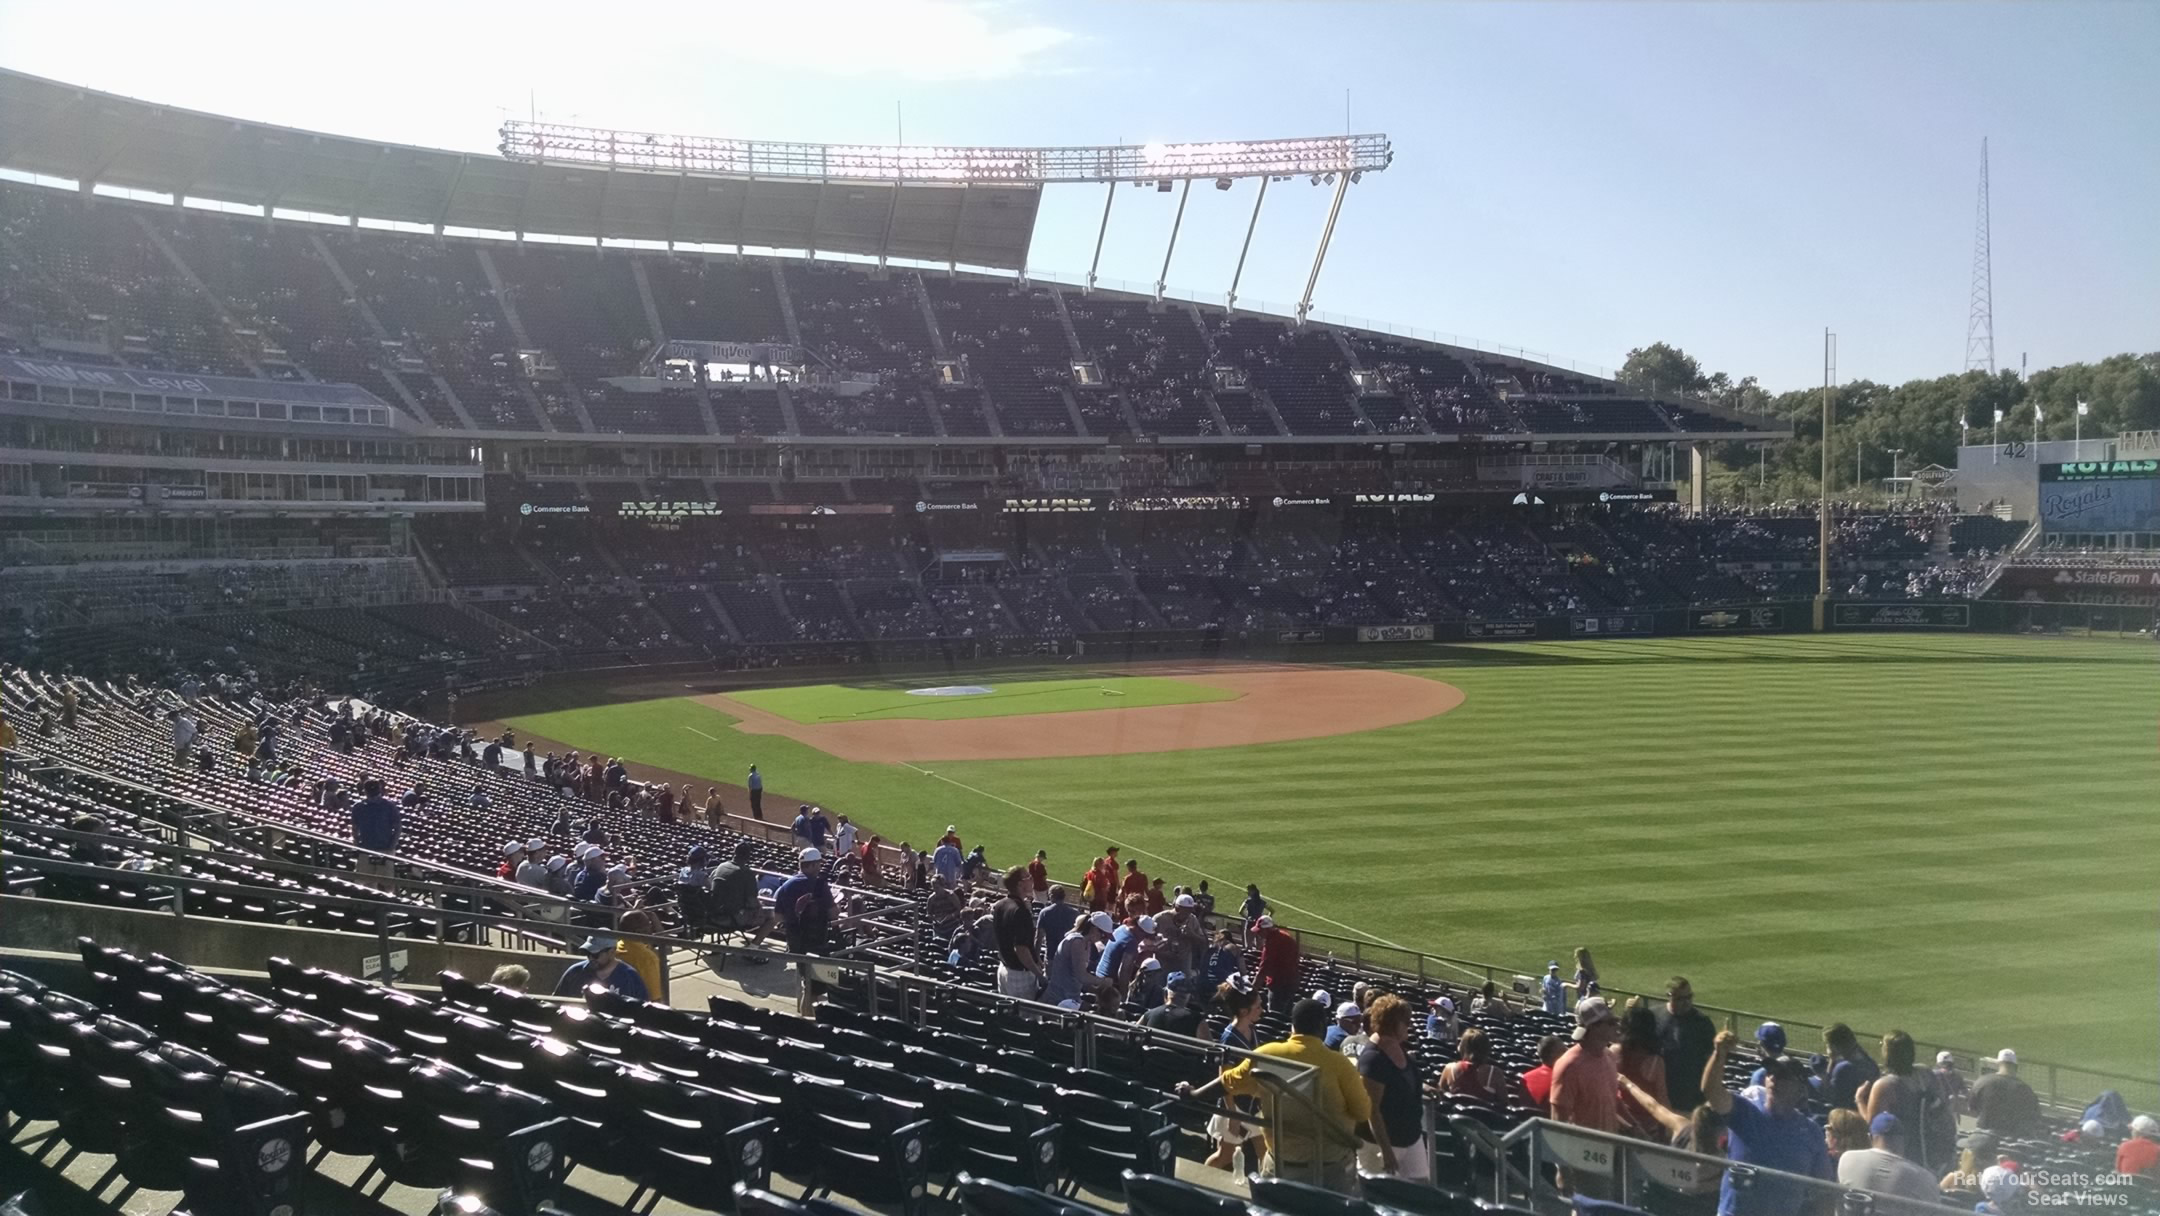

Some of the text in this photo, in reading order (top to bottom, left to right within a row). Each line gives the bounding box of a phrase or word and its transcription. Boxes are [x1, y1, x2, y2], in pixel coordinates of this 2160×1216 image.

[124, 371, 212, 393] Level
[2003, 442, 2026, 459] 42
[533, 505, 590, 513] Commerce Bank
[927, 503, 961, 511] Commerce
[2046, 484, 2114, 519] Royals
[1583, 1150, 1608, 1165] 246
[1671, 1168, 1692, 1182] 146
